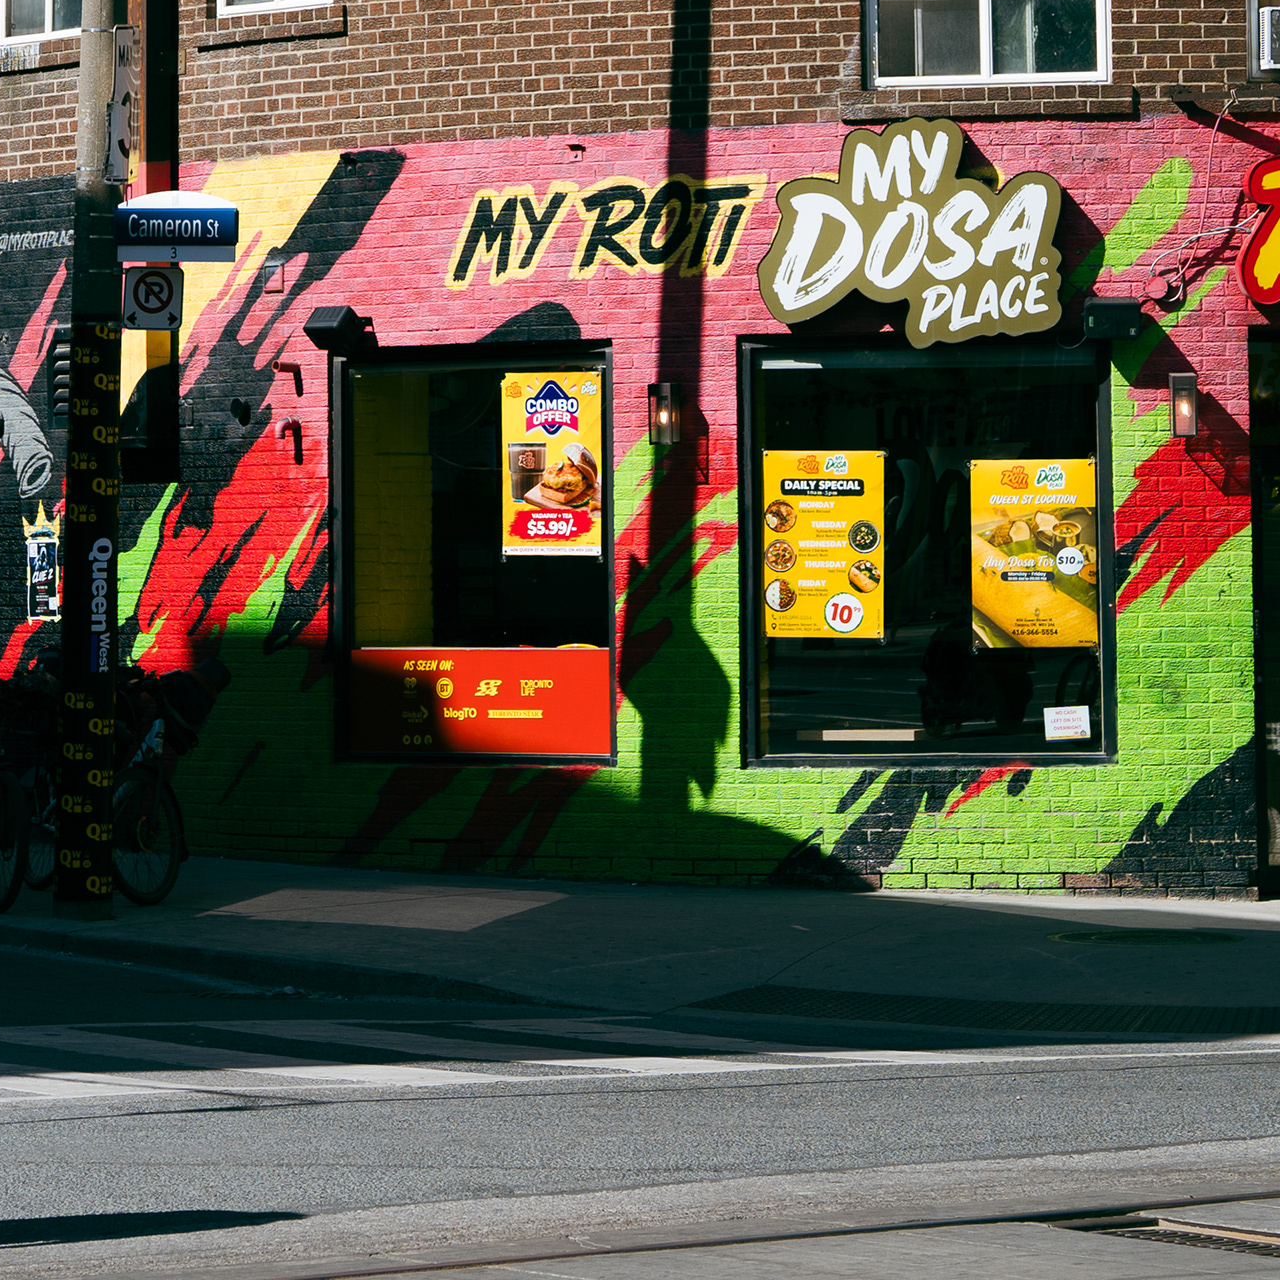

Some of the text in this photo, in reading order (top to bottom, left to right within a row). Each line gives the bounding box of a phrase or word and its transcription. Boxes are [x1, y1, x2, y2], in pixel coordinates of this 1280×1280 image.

[851, 130, 948, 204] MY
[128, 214, 219, 238] Cameron St
[453, 184, 751, 283] MY ROTI
[171, 247, 178, 258] 3
[773, 187, 1050, 311] DOSA
[920, 272, 1048, 336] PLACE
[527, 399, 578, 413] COMBO
[533, 411, 571, 425] OFFER
[1037, 470, 1063, 484] DOSA
[785, 481, 860, 490] DAILY SPECIAL
[990, 495, 1077, 505] QUEEN ST LOCATION
[527, 519, 577, 536] $5.99/-
[798, 540, 847, 548] WEDNESDAY
[984, 556, 1006, 570] Any
[1008, 556, 1035, 568] Dosa
[1058, 556, 1076, 565] $10
[88, 537, 113, 673] Queen West
[831, 603, 853, 624] 10
[403, 660, 455, 671] AS SEEN ON:
[440, 683, 450, 693] BT
[475, 687, 499, 696] 24
[520, 680, 553, 689] TORONTO
[521, 687, 535, 696] LIFE
[444, 708, 477, 721] blogTO
